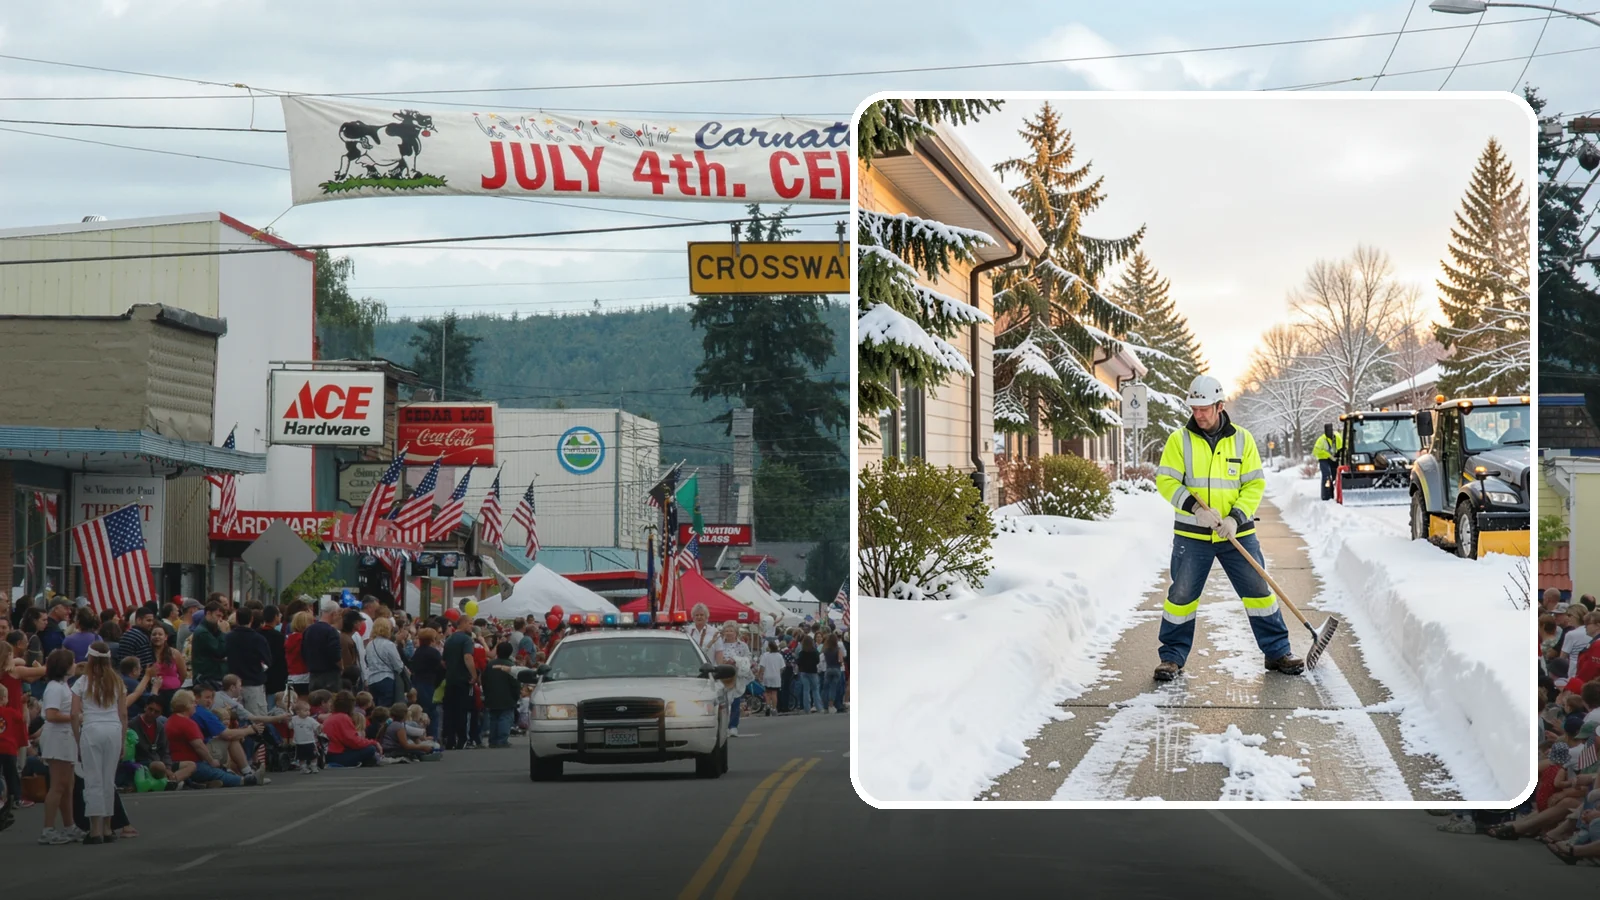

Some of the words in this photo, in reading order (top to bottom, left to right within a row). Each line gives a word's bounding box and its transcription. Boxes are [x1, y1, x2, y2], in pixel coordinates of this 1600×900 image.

[695, 121, 850, 149] Carnat
[481, 140, 605, 192] JULY
[632, 150, 746, 197] 4th.
[697, 254, 850, 279] CROSSWA
[282, 380, 373, 420] ACE
[406, 409, 452, 421] CEDAR
[461, 409, 485, 421] LOG
[283, 421, 371, 436] Hardware
[416, 428, 477, 447] Coca-Cola
[353, 467, 384, 480] Simpl
[95, 485, 124, 494] Vincent
[126, 485, 135, 494] de
[137, 485, 155, 495] Paul
[212, 516, 331, 535] HARDARE
[688, 526, 741, 535] CRNATION
[699, 535, 730, 543] GLASS
